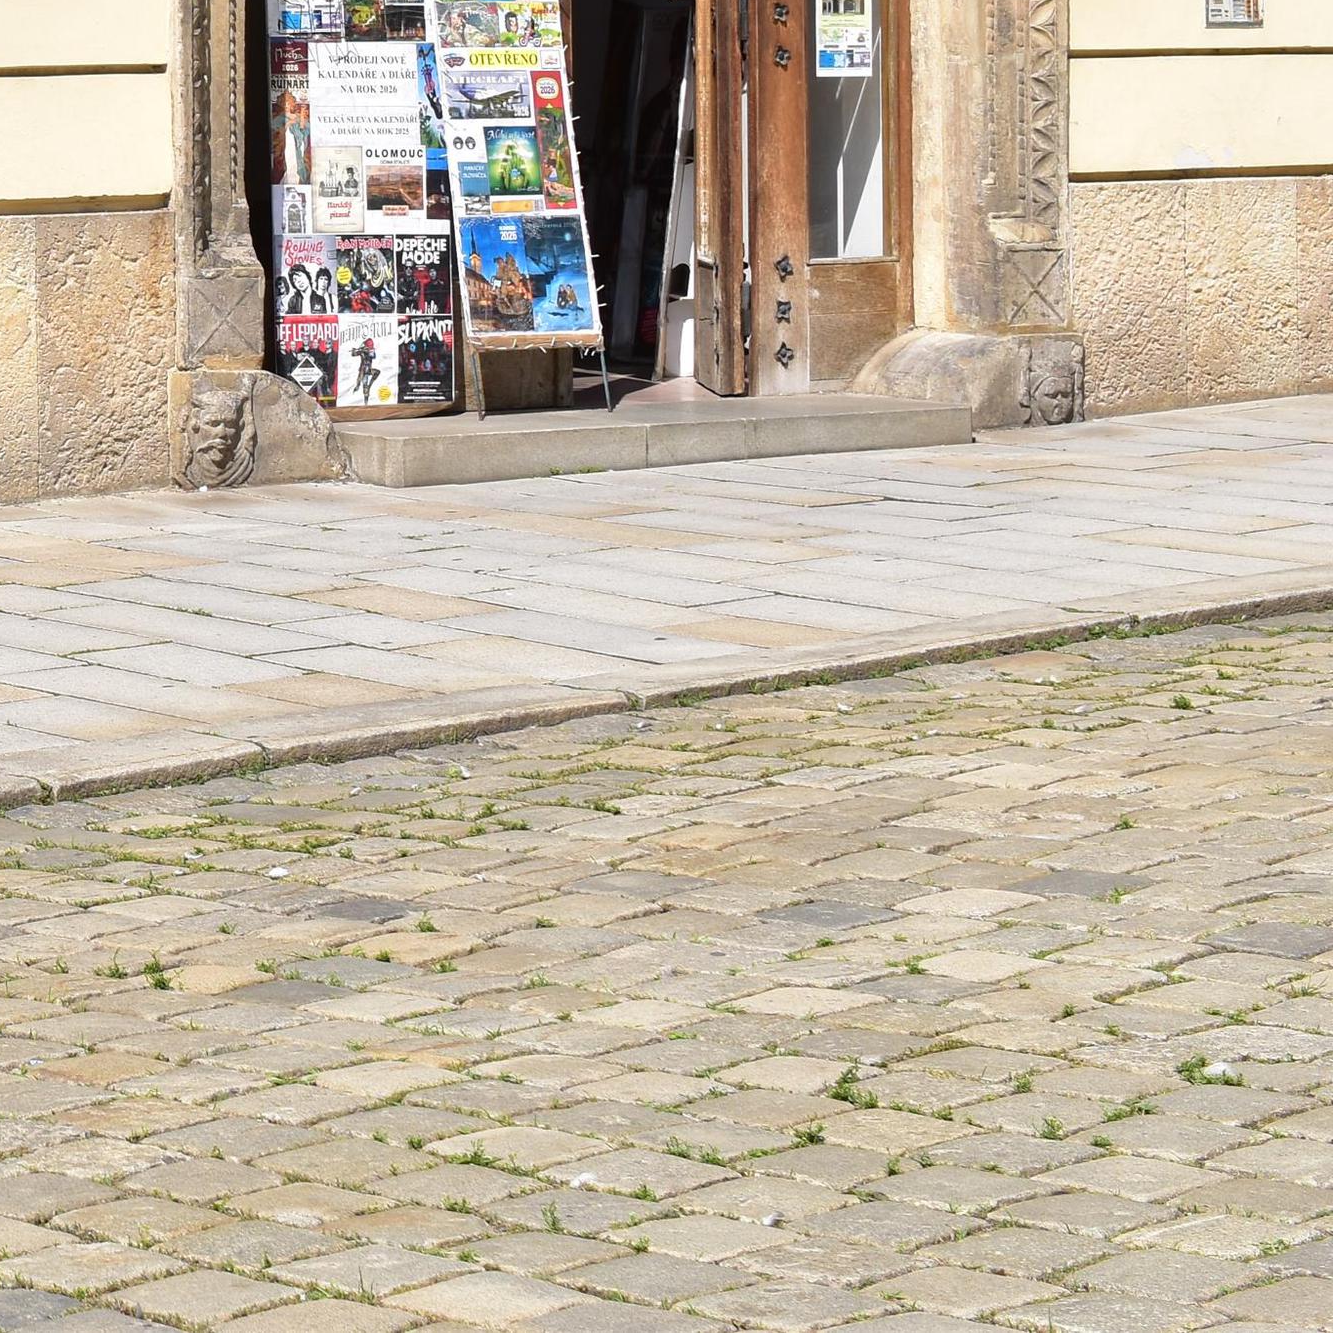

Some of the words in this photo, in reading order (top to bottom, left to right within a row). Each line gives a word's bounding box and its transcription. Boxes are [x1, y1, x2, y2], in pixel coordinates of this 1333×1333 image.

[337, 55, 379, 65] PRODEJI
[381, 54, 406, 65] NOVÉ
[469, 50, 538, 66] OTEVŘENO
[318, 69, 377, 80] KALENDÁŘE
[387, 69, 417, 80] DIÁŘE
[271, 79, 309, 89] RUINART
[340, 85, 354, 94] NA
[355, 85, 377, 94] ROK
[379, 85, 398, 94] 2026
[365, 148, 424, 158] OLOMOUC
[395, 238, 447, 252] DEPECHE
[401, 251, 441, 266] MODE
[293, 323, 339, 341] LEPPARD
[397, 319, 453, 346] SLIPKNOT
